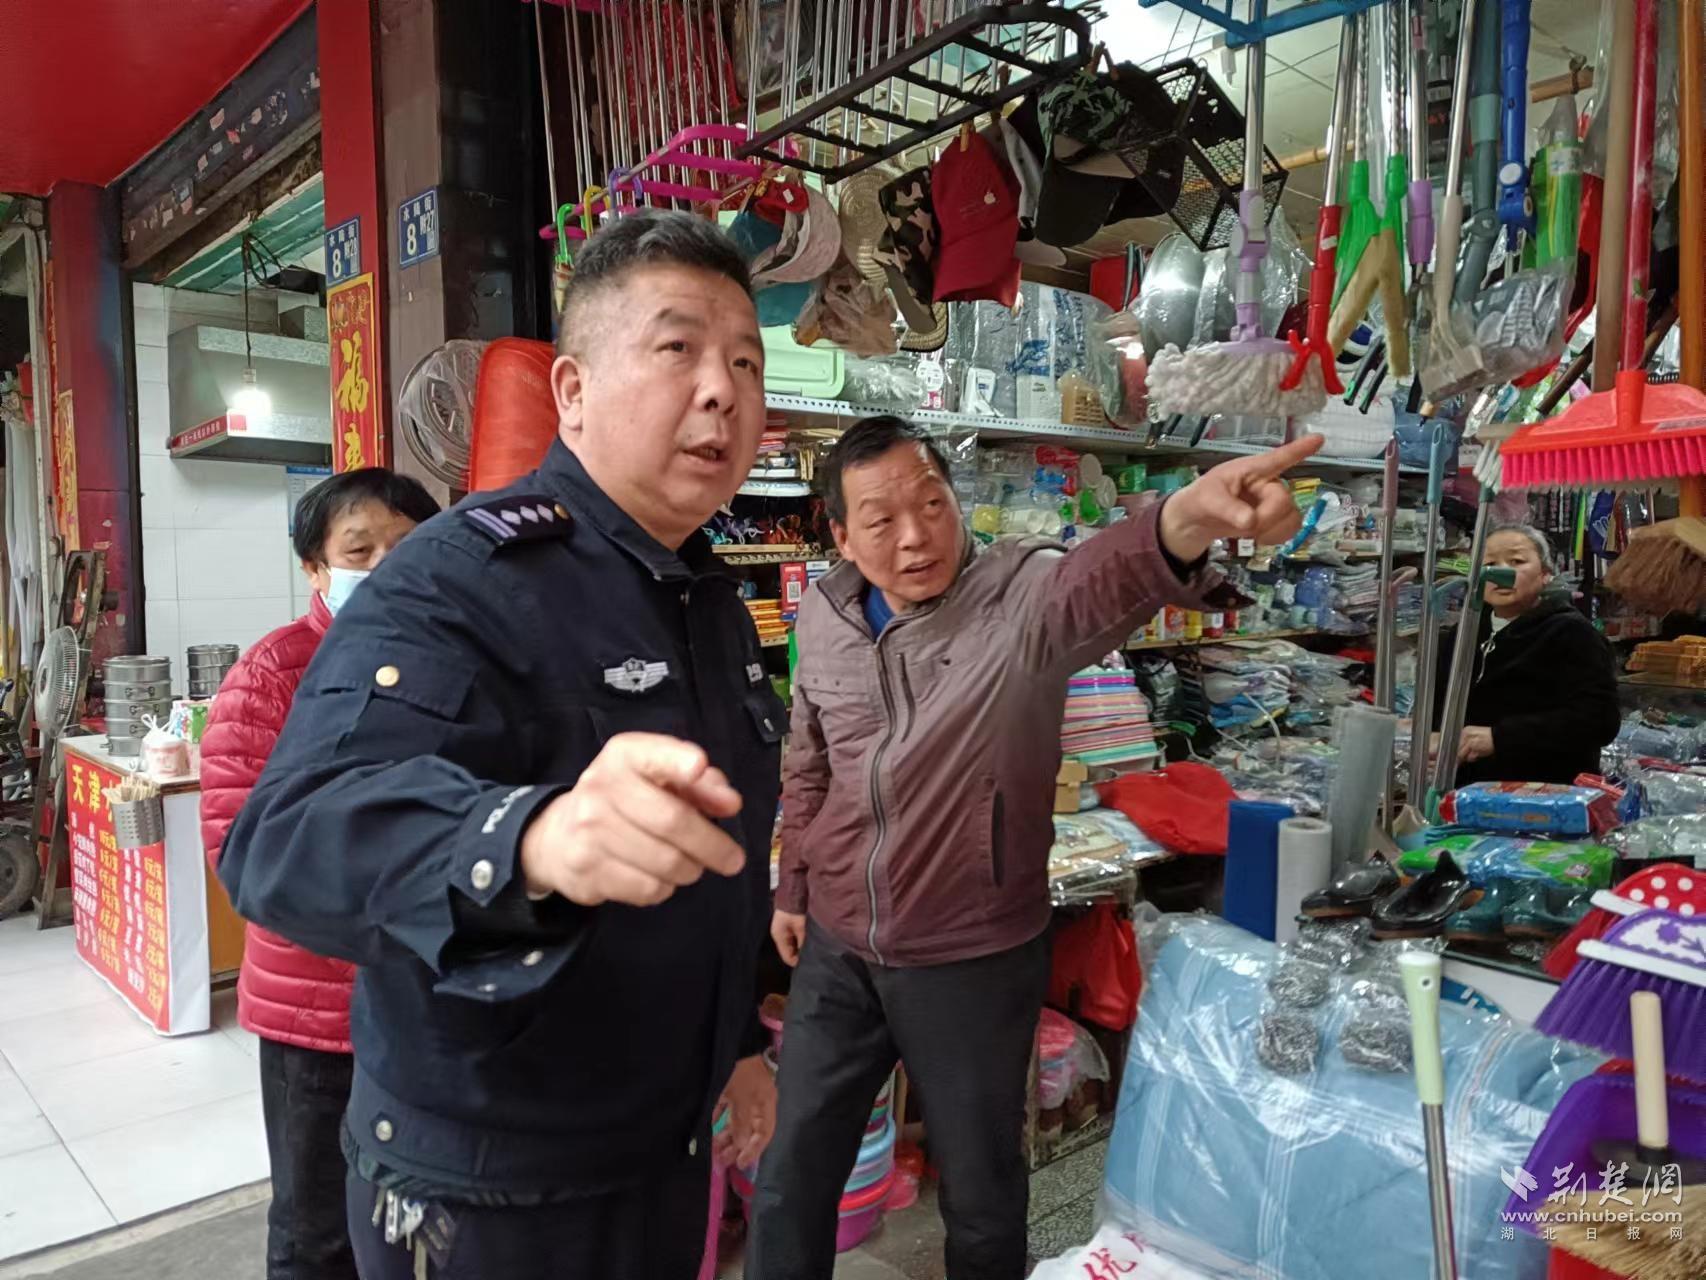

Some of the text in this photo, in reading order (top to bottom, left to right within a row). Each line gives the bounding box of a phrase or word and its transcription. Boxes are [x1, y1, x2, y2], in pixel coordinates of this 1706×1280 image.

[407, 223, 417, 255] 8
[332, 248, 342, 278] 8
[72, 764, 113, 823] 天津
